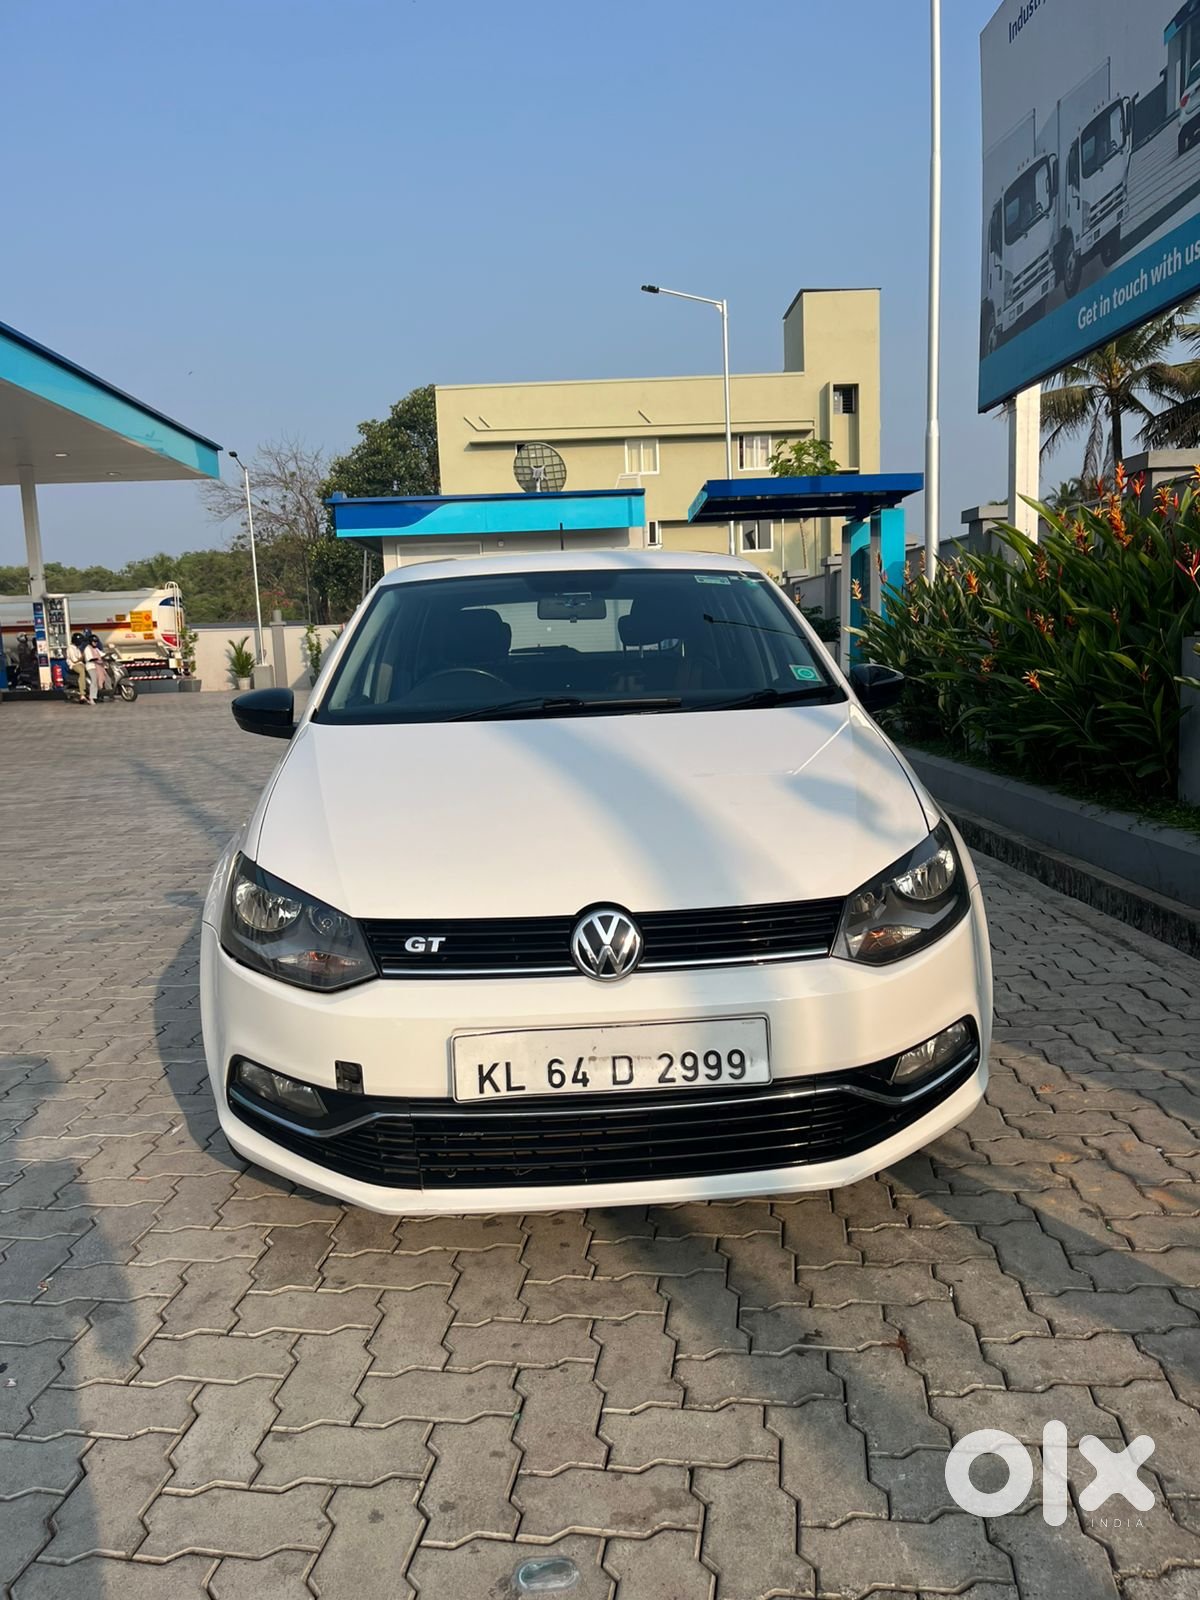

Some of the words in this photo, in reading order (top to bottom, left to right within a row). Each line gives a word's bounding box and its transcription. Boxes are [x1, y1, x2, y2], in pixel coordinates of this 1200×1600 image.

[1009, 0, 1046, 44] Indus
[1078, 301, 1097, 329] Get
[1100, 295, 1110, 318] in
[1113, 268, 1148, 309] touch
[1151, 247, 1182, 286] with
[1185, 239, 1200, 265] us
[404, 936, 446, 953] GT
[477, 1061, 526, 1095] KL
[547, 1056, 590, 1089] 64
[611, 1055, 634, 1086] D
[657, 1048, 747, 1084] 2999
